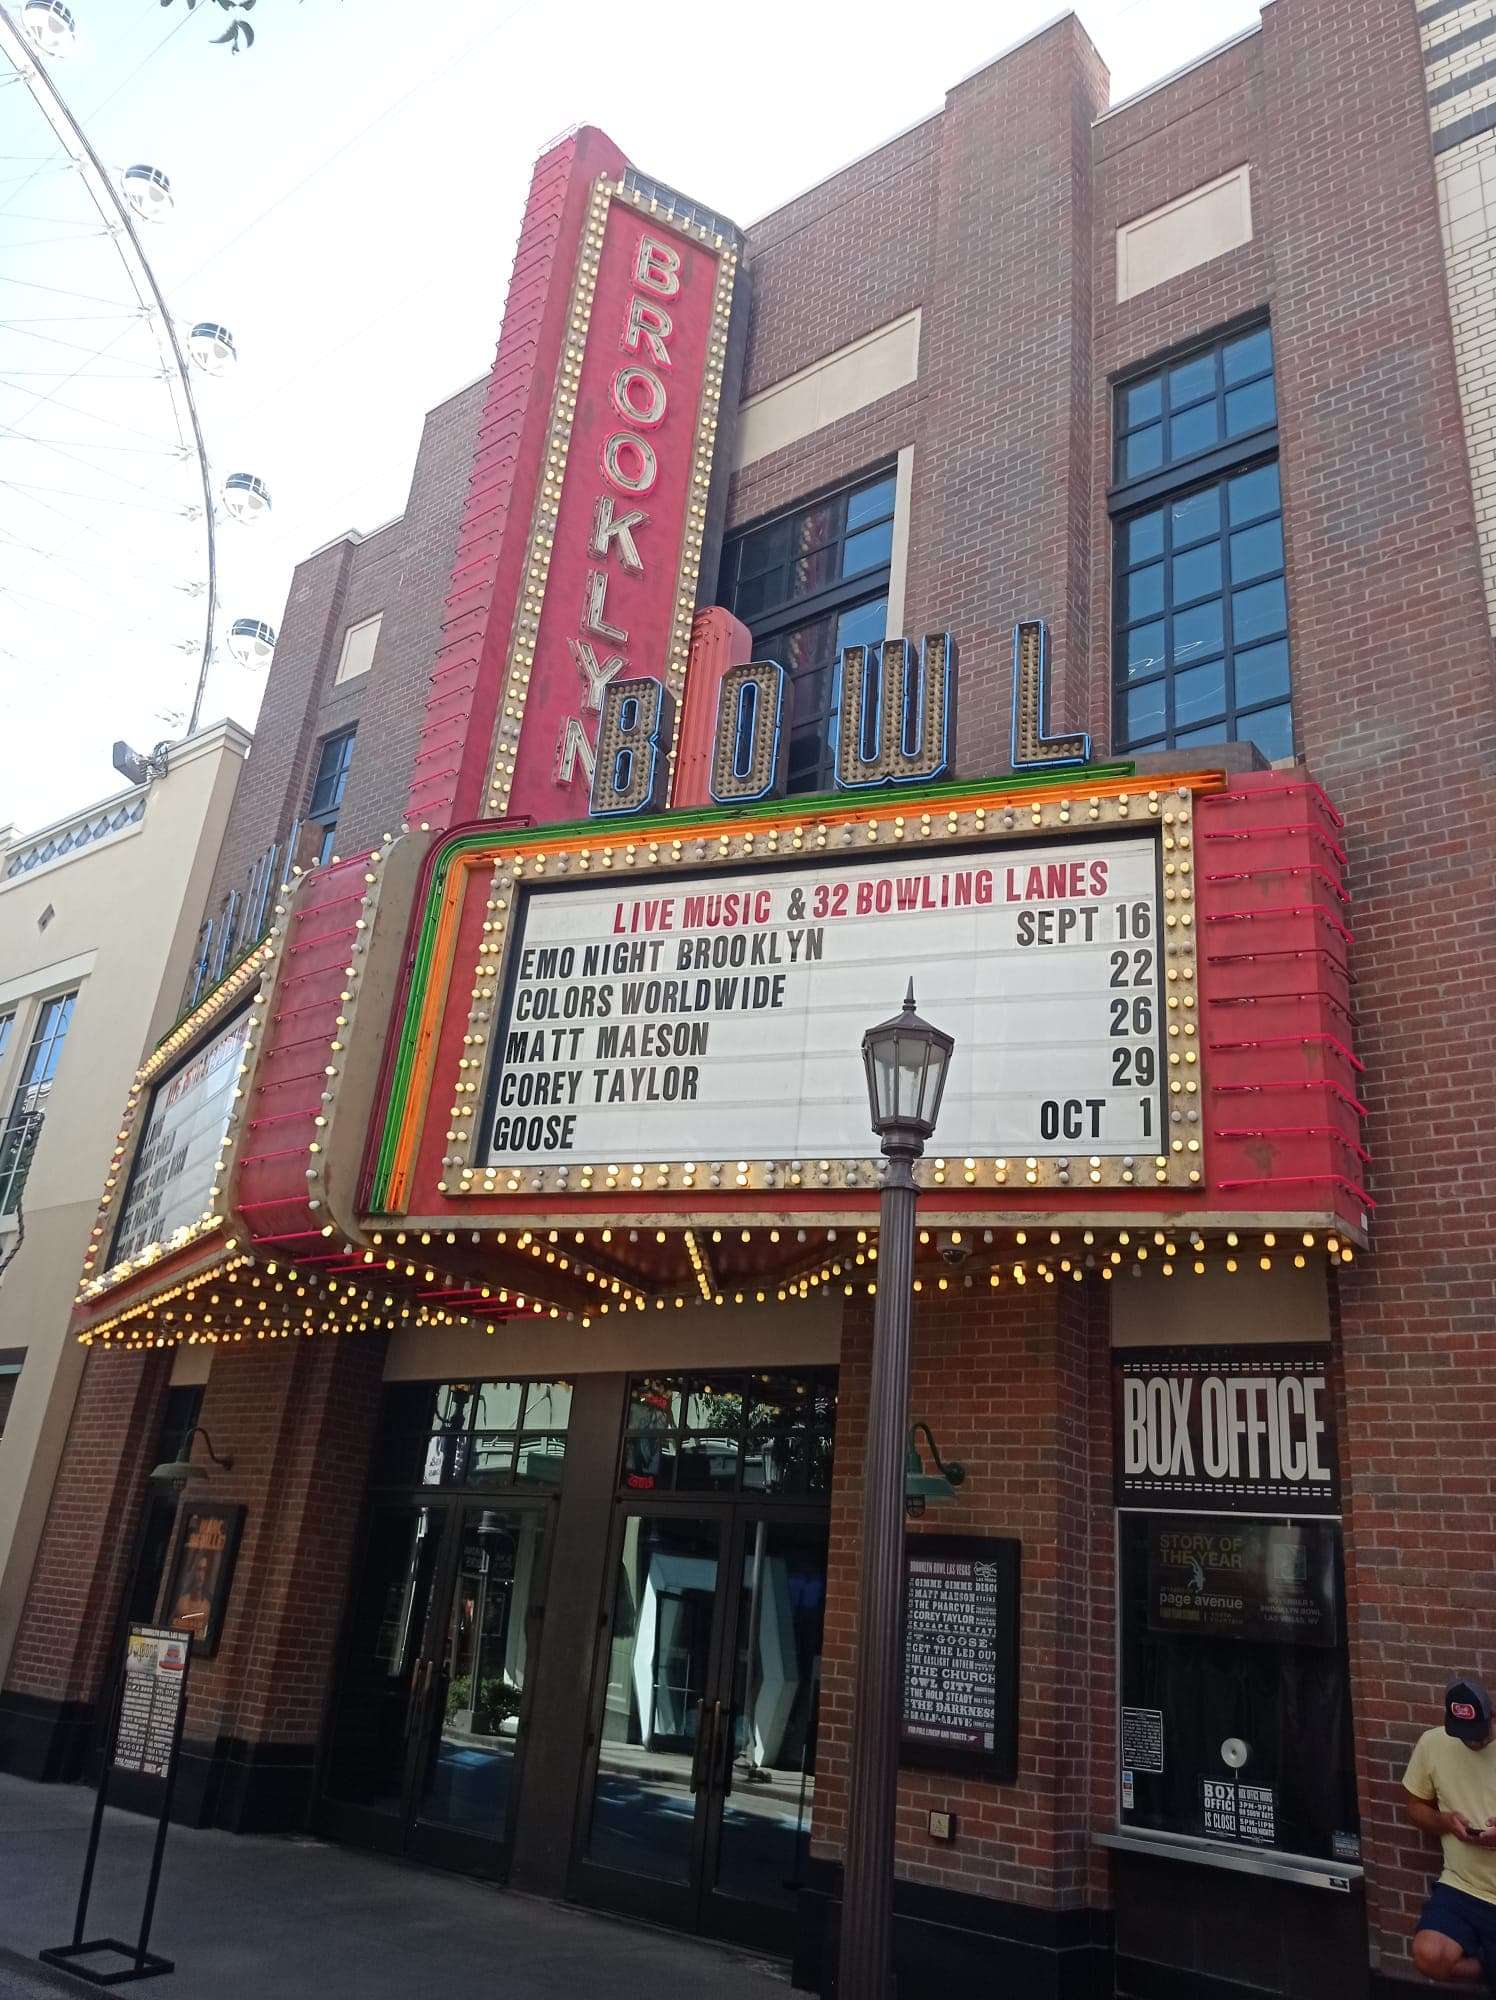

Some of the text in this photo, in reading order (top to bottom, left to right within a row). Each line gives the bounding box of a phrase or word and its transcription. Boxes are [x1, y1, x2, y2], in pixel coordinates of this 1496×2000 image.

[555, 233, 681, 791] BROOKLYN
[589, 619, 1092, 818] BOWL
[613, 860, 1108, 933] LIVE MUSIC & 32 BOWLING LANES
[1016, 902, 1151, 947] SEPT 16
[520, 928, 824, 980] EMO NIGHT BROOKLYN
[1110, 949, 1153, 988] 22
[516, 974, 787, 1021] COLORS WORLDWIDE
[1110, 996, 1152, 1037] 26
[505, 1022, 709, 1064] MATT MAESON
[1112, 1046, 1155, 1087] 29
[500, 1065, 699, 1107] COREY TAYLOR
[493, 1115, 577, 1151] GOOSE
[1040, 1098, 1152, 1140] OCT 1
[1123, 1376, 1331, 1481] BOX OFFICE
[1160, 1535, 1243, 1551] STORY OF
[1160, 1549, 1243, 1569] THE YEAR
[914, 1611, 941, 1621] COREY
[942, 1613, 974, 1624] TAYLOR
[915, 1600, 931, 1610] THE
[932, 1601, 975, 1613] PHARCYDE
[1160, 1592, 1243, 1608] page avenue
[912, 1643, 931, 1653] GET
[933, 1645, 953, 1656] THE
[956, 1647, 975, 1658] LED
[936, 1635, 988, 1648] GOOSE
[910, 1676, 938, 1688] OWL
[942, 1681, 974, 1693] CITY
[911, 1665, 938, 1677] THE
[910, 1687, 924, 1698] THE
[925, 1690, 944, 1700] HOLD
[946, 1692, 974, 1705] STEADY
[911, 1699, 933, 1711] THE
[1204, 1783, 1235, 1800] BOX
[1204, 1812, 1212, 1827] IS
